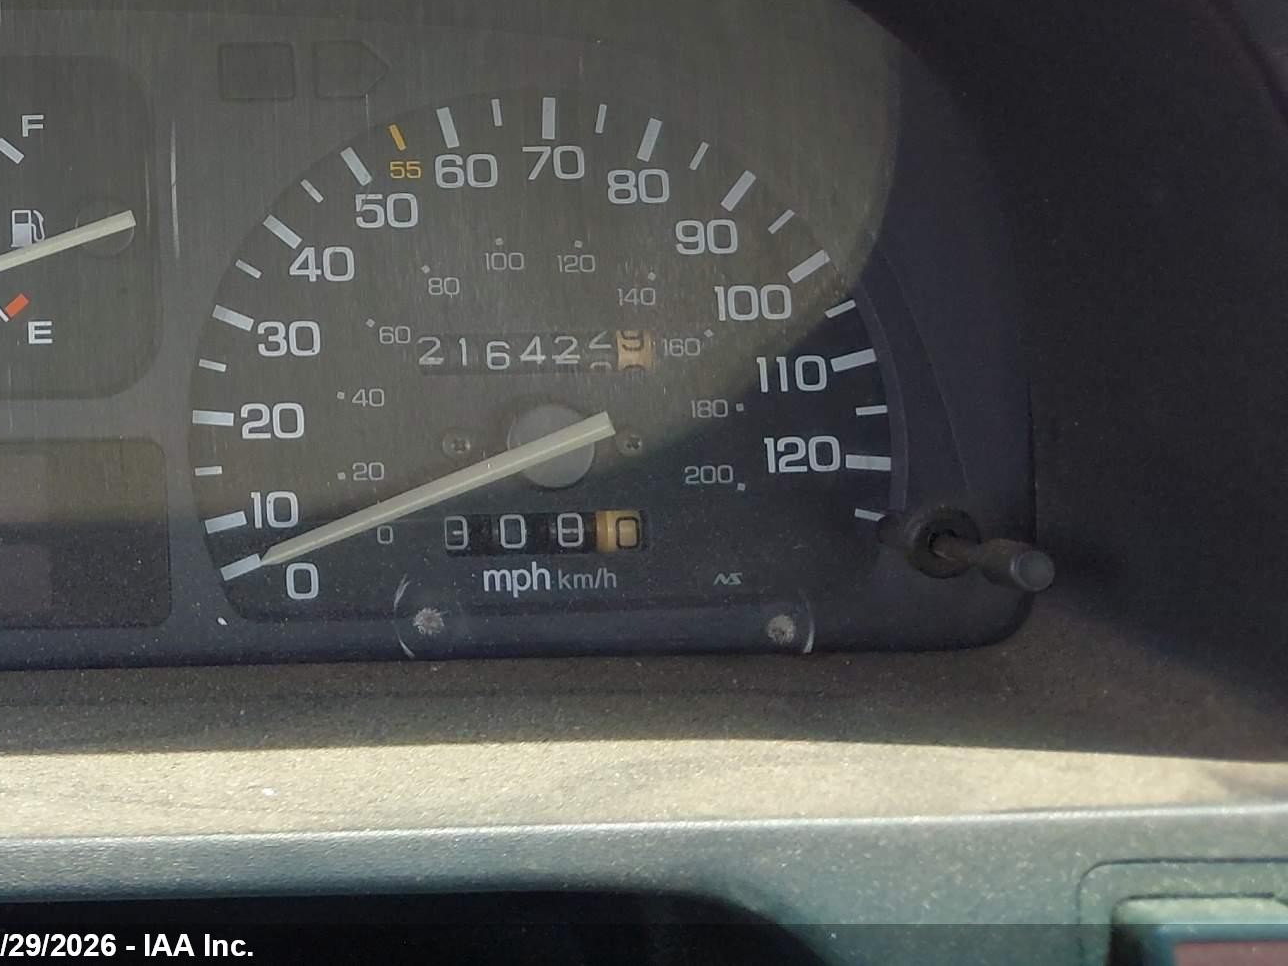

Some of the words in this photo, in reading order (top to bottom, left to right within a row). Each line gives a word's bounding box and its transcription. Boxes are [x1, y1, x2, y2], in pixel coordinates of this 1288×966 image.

[22, 115, 44, 137] F
[390, 162, 421, 179] 55
[435, 154, 498, 188] 60
[522, 146, 584, 180] 70
[608, 169, 669, 203] 80
[355, 193, 418, 228] 50
[674, 220, 737, 255] 90
[289, 247, 354, 282] 40
[484, 253, 524, 272] 100
[558, 255, 595, 273] 120
[428, 277, 460, 296] 80
[617, 288, 655, 306] 140
[714, 285, 791, 321] 100
[28, 321, 53, 344] E
[258, 322, 320, 356] 30
[379, 326, 411, 344] 60
[663, 338, 700, 356] 160
[756, 356, 826, 392] 110
[351, 388, 384, 407] 40
[691, 400, 728, 418] 180
[241, 404, 304, 439] 20
[764, 436, 840, 473] 120
[352, 463, 384, 482] 20
[684, 466, 733, 485] 200
[252, 492, 298, 527] 10
[377, 526, 393, 544] 0
[286, 563, 318, 600] 0
[483, 562, 550, 597] mph
[557, 568, 617, 590] km/h
